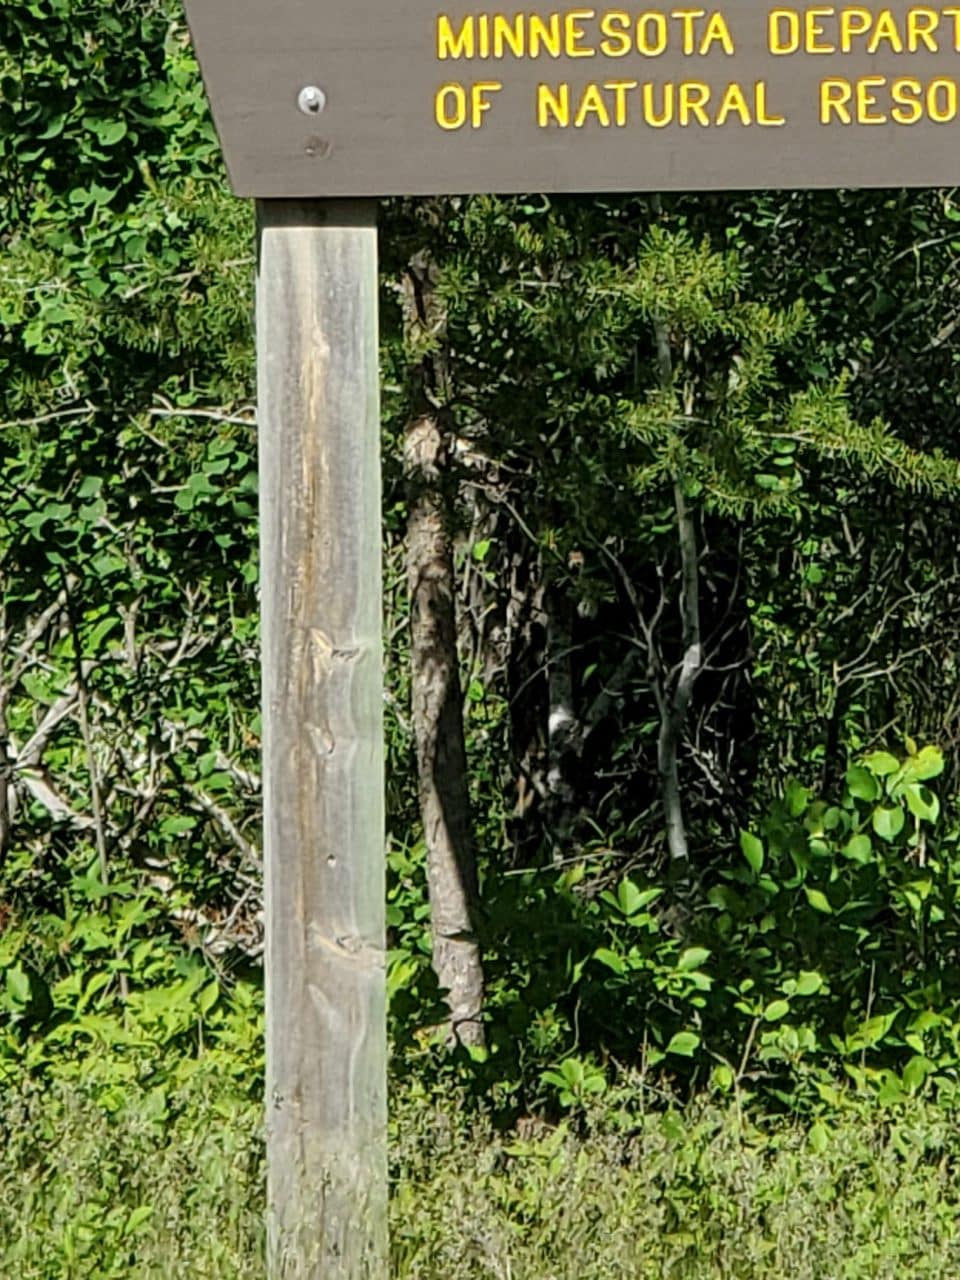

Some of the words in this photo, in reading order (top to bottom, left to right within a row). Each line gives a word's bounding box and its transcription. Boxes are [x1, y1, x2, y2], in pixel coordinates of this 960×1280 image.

[435, 7, 738, 62] MINNESOTA
[434, 80, 503, 131] OF
[536, 78, 785, 129] NATURAL
